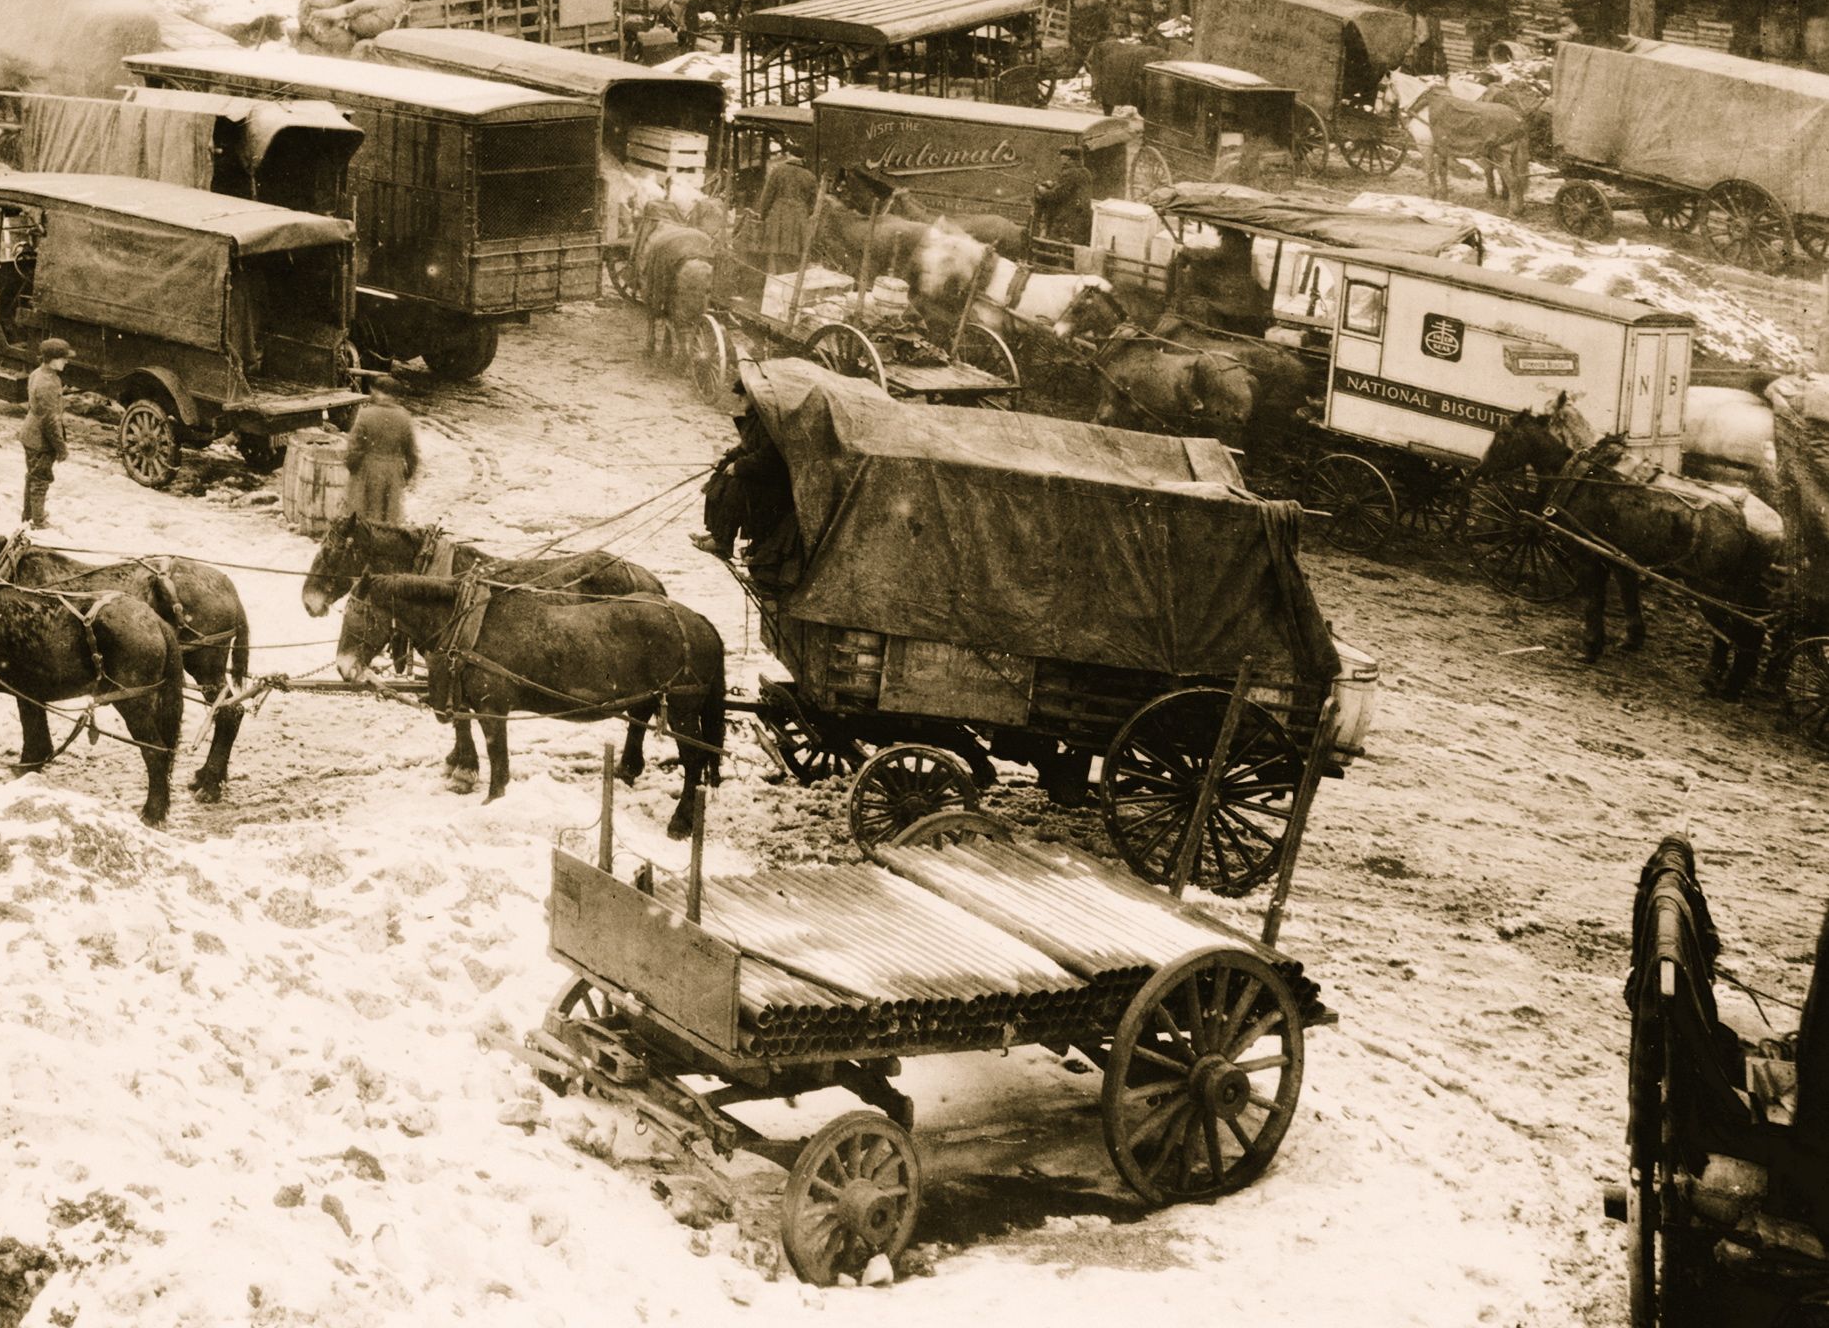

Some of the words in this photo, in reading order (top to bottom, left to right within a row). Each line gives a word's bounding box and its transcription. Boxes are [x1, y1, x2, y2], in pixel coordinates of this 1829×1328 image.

[866, 121, 895, 140] VISIT
[899, 120, 921, 132] THE
[866, 138, 1018, 170] Automats
[1638, 374, 1650, 397] N
[1668, 374, 1679, 397] B
[1345, 374, 1432, 410] NATIONAL
[1440, 398, 1513, 428] BISCUIT
